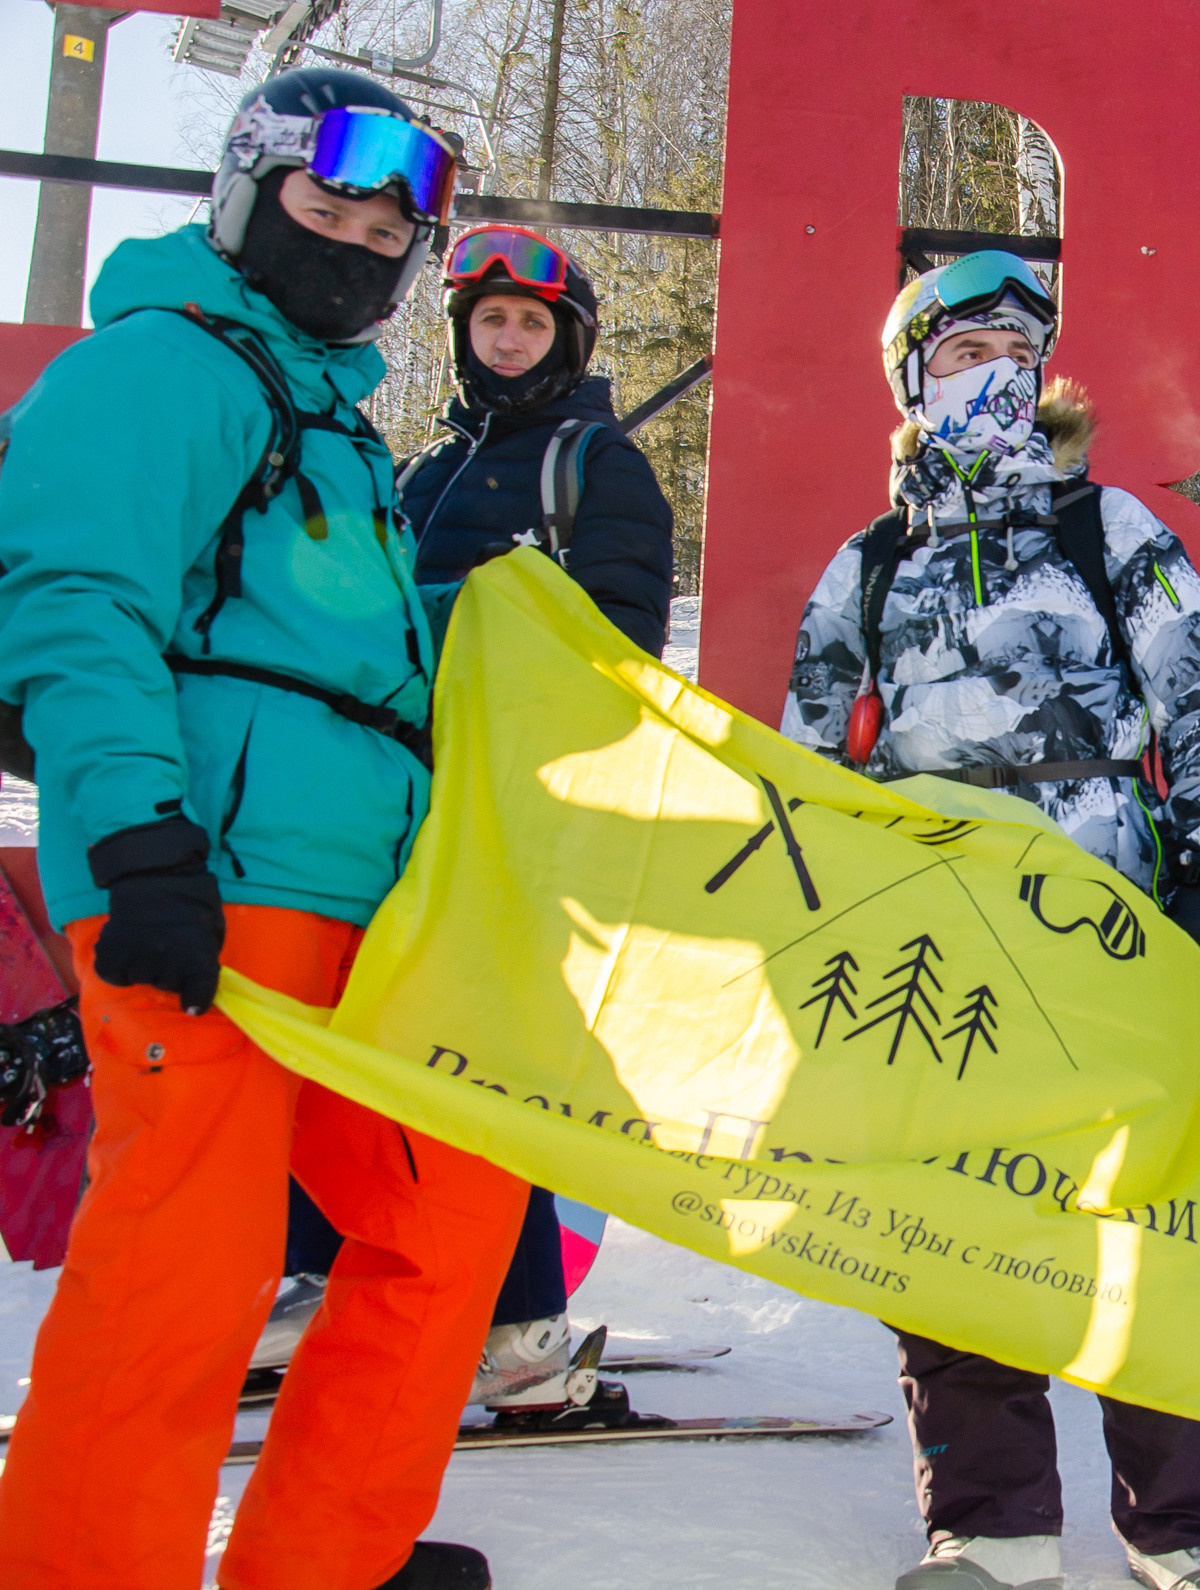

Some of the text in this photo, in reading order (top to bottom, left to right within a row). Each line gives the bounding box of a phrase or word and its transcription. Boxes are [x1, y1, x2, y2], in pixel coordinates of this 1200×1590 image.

[73, 42, 85, 55] 4
[862, 563, 885, 632] AKINE
[671, 1190, 911, 1294] @snowskitours
[824, 1191, 871, 1229] Из
[962, 1245, 981, 1264] с
[984, 1256, 1130, 1306] любовью.
